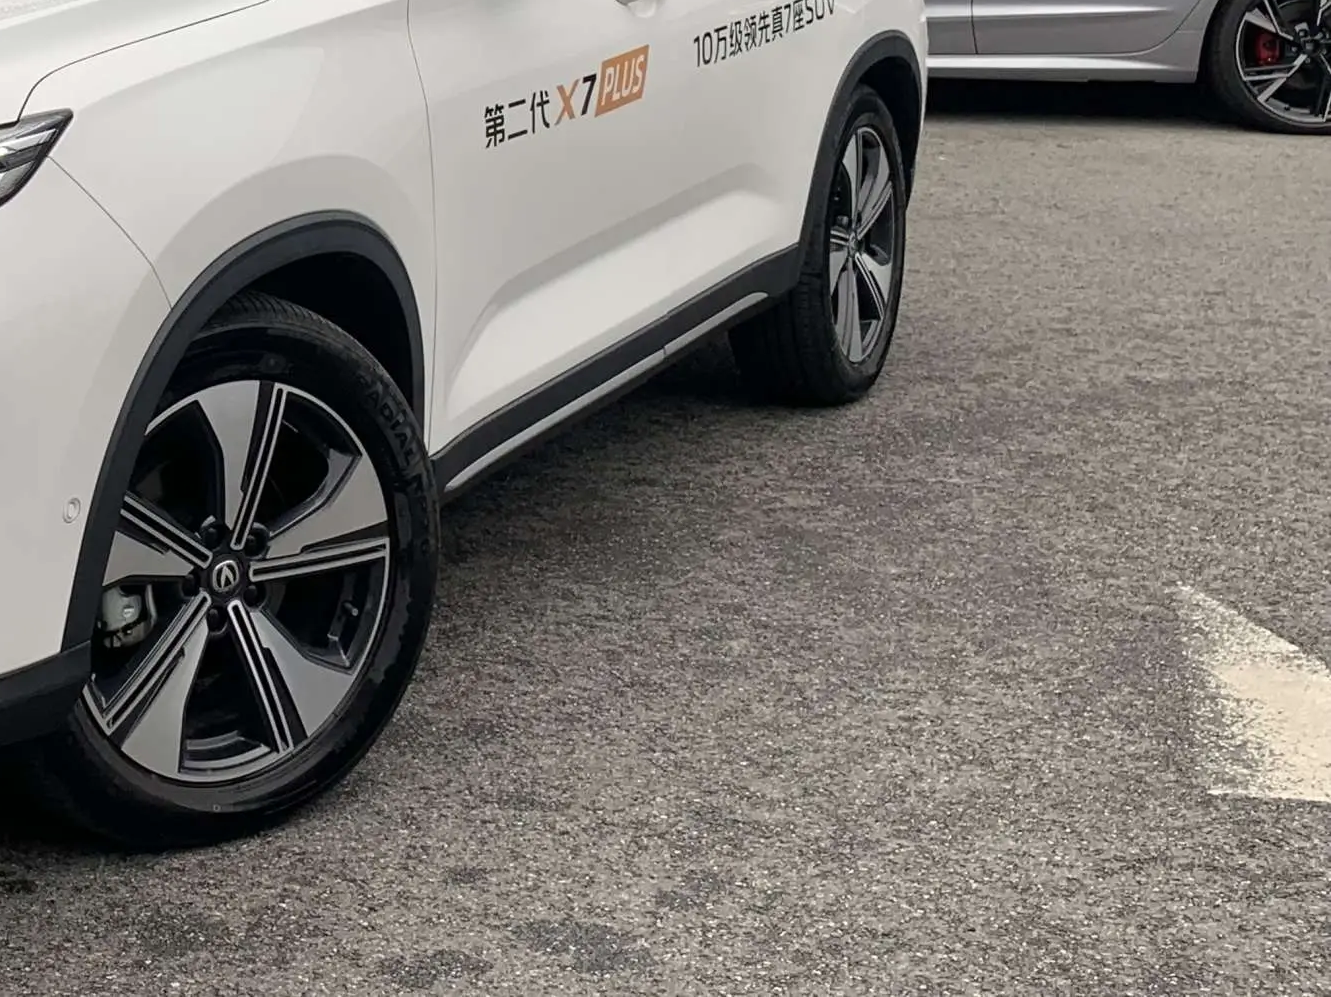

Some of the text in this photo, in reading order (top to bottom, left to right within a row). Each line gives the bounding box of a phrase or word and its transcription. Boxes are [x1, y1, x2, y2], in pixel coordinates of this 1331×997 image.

[484, 90, 551, 149] 第二代
[600, 54, 646, 106] PLUS
